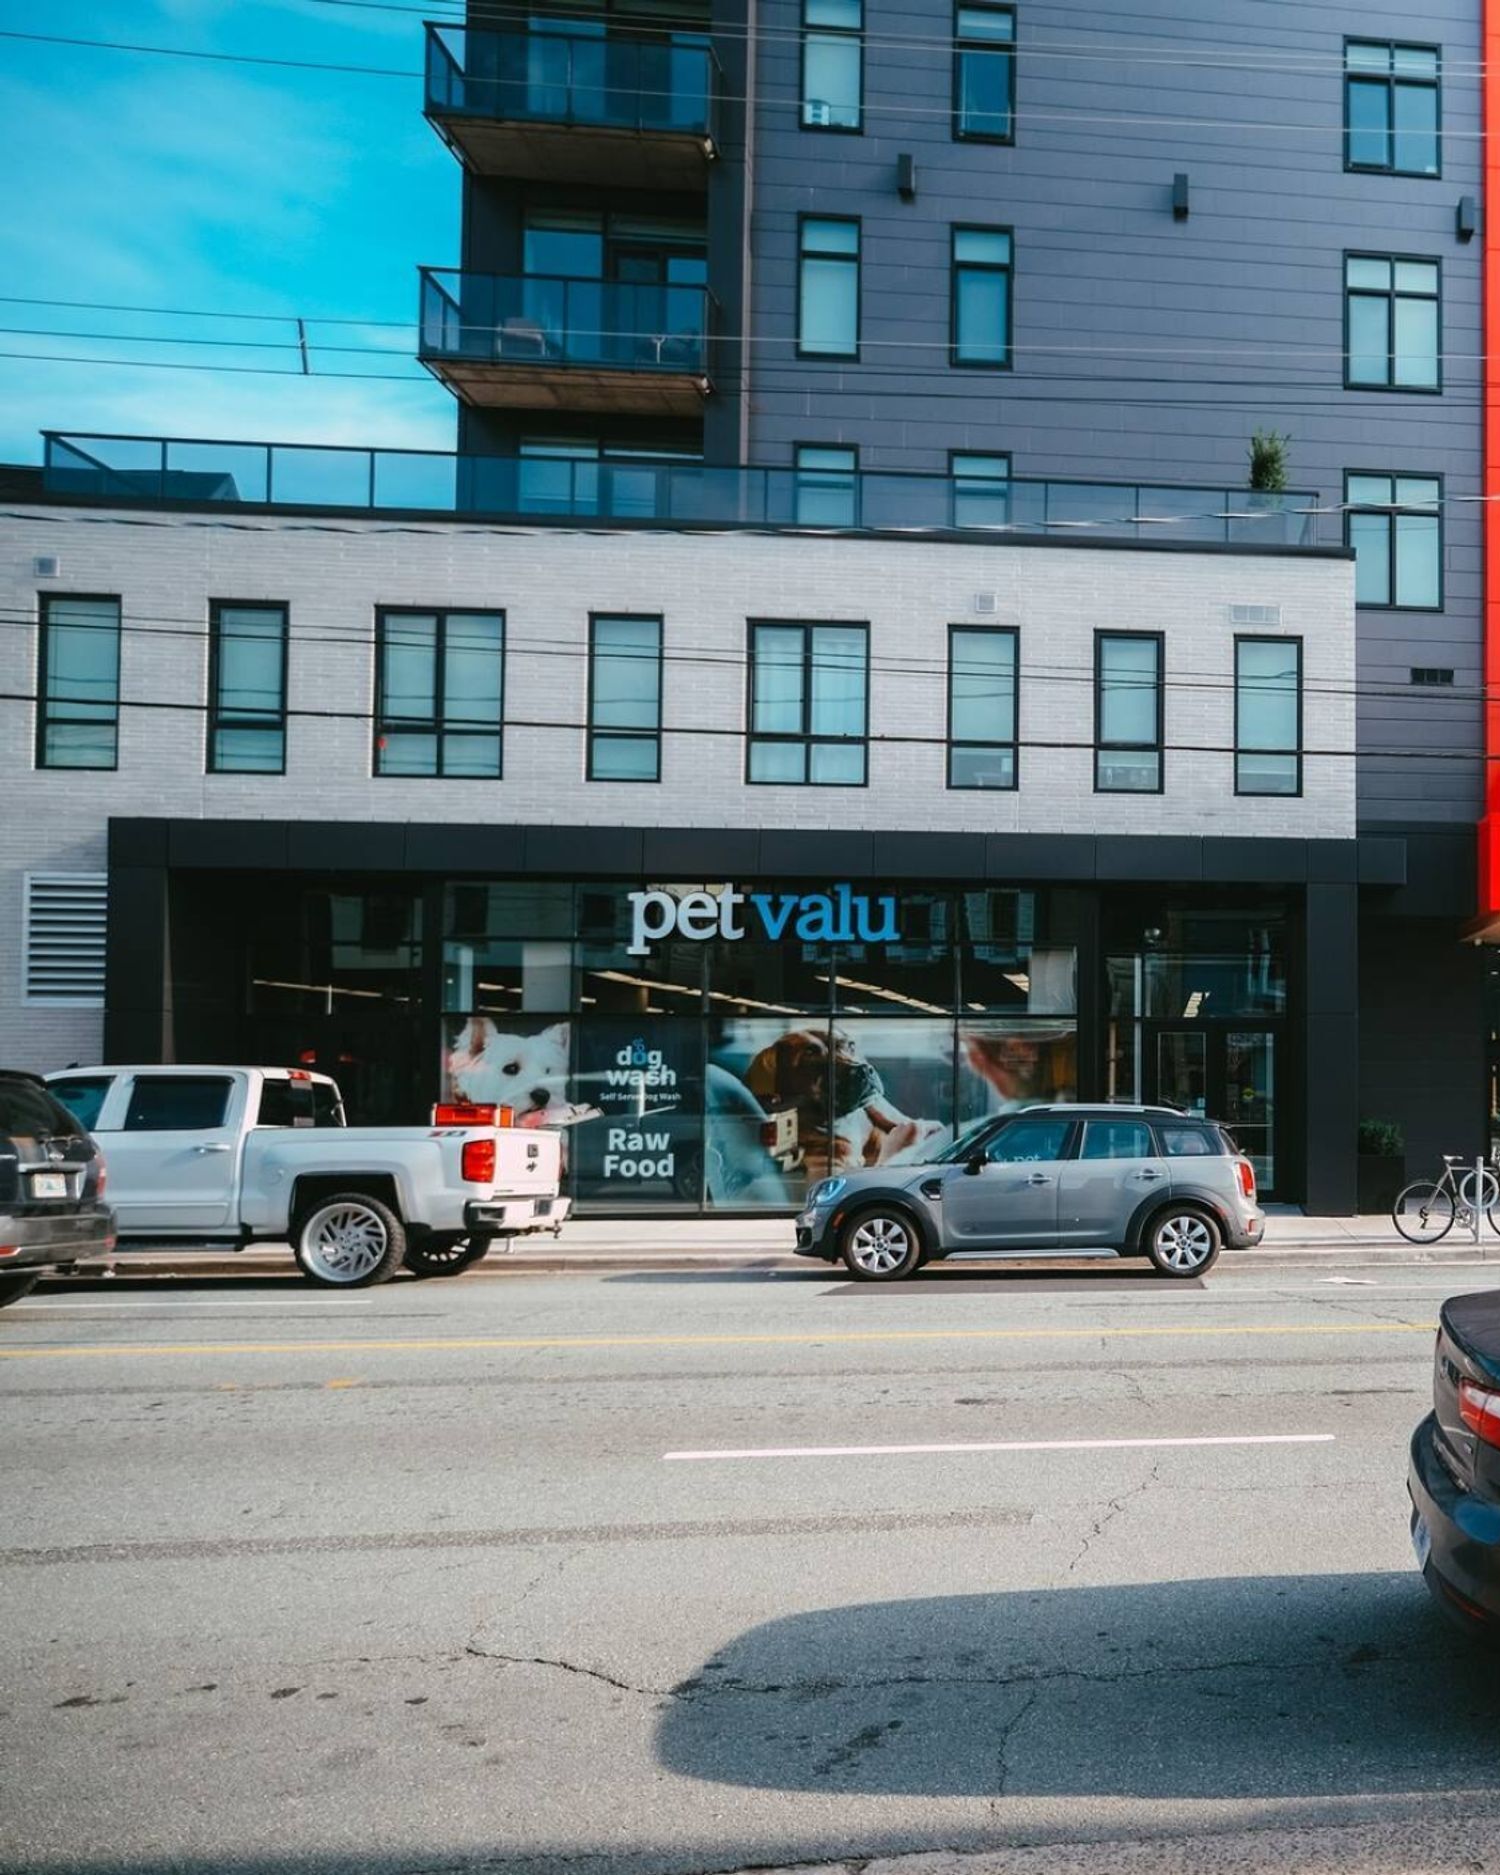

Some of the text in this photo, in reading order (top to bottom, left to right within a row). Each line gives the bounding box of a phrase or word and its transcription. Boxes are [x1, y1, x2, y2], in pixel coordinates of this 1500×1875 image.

[627, 883, 901, 955] pet valu
[616, 1045, 662, 1069] dog
[605, 1064, 677, 1086] wash
[600, 1092, 616, 1101] Self
[659, 1092, 682, 1101] Wash
[608, 1128, 670, 1151] Raw
[603, 1153, 675, 1178] Food
